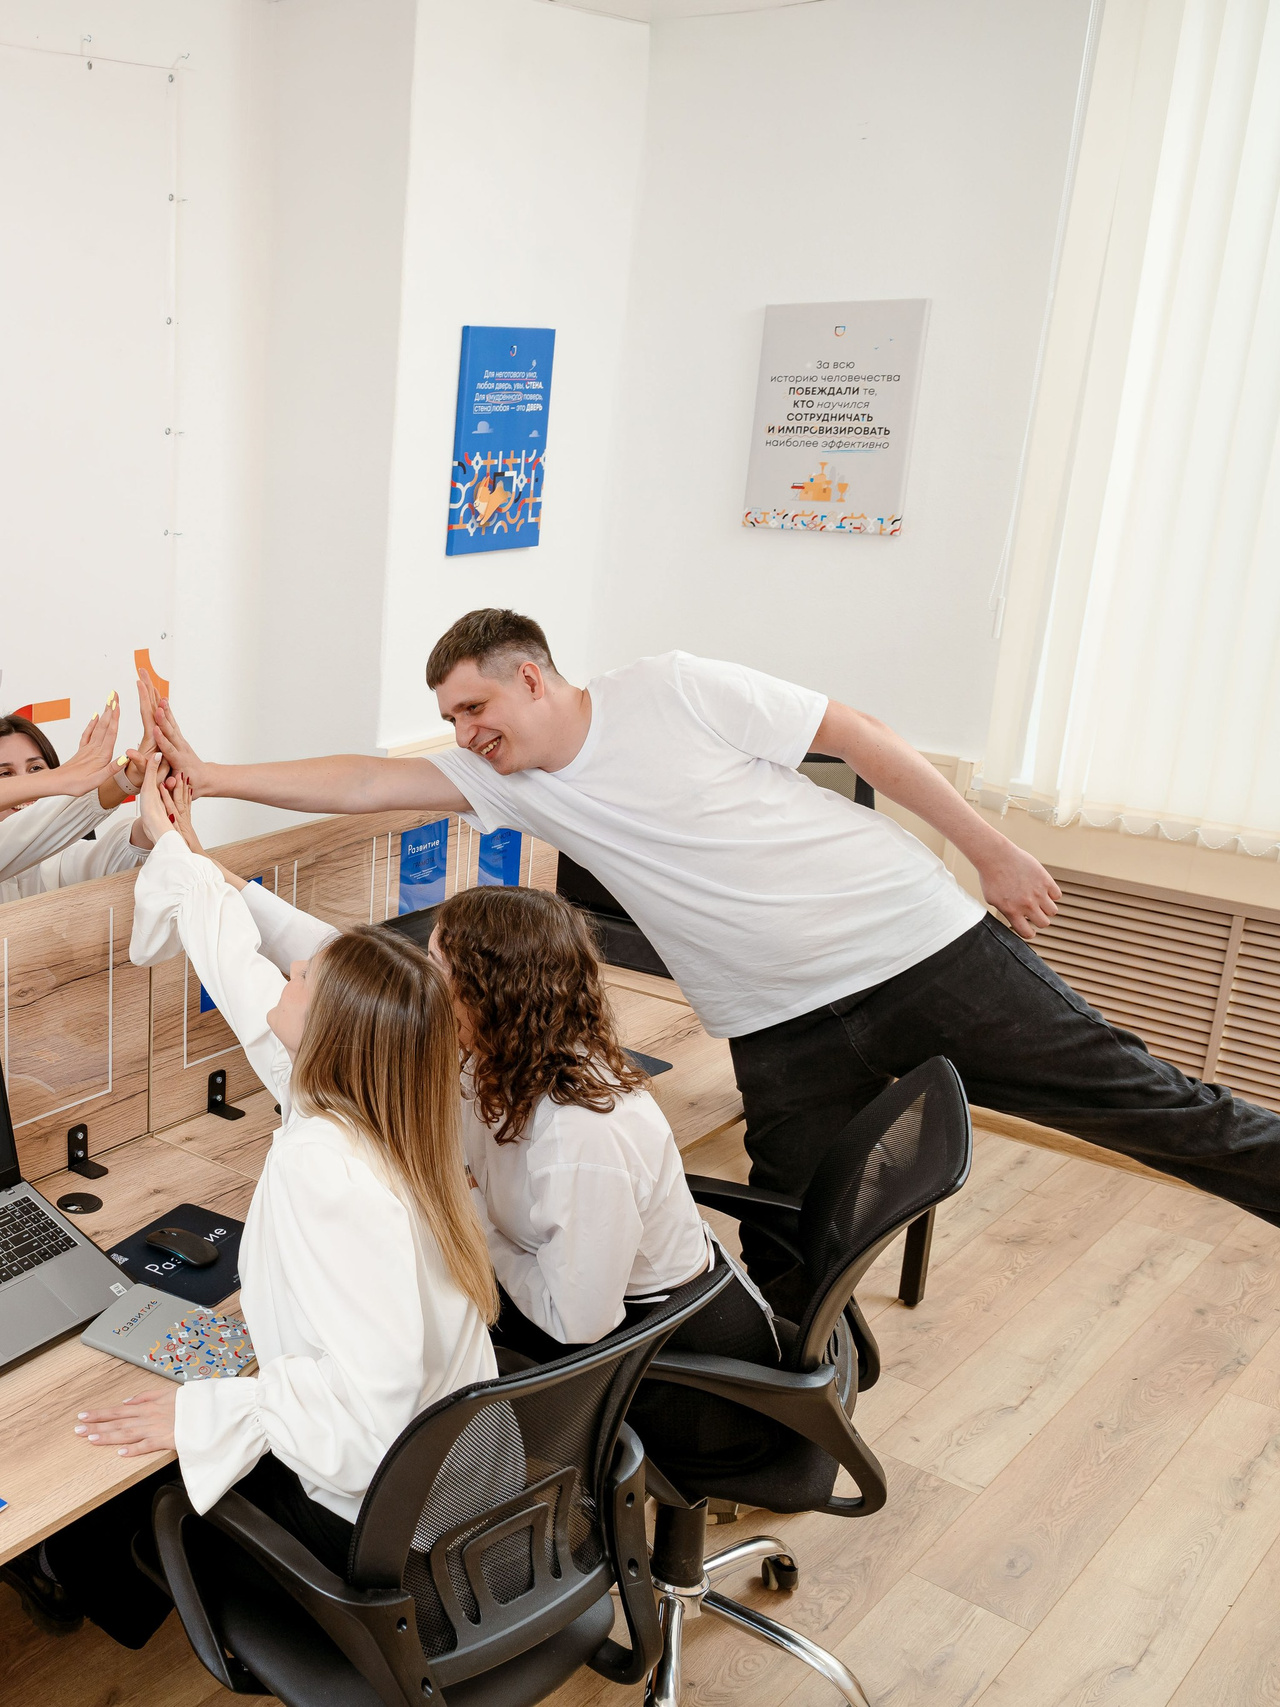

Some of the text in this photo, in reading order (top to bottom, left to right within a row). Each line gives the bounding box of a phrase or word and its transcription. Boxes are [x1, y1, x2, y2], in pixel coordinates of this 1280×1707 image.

[816, 360, 855, 369] За всю
[484, 370, 494, 379] Для
[770, 374, 900, 384] историю человечества
[476, 381, 495, 390] любая
[788, 386, 878, 396] ПОБЕЖДАЛИ те,
[474, 393, 485, 402] Для
[492, 403, 510, 412] любая
[526, 403, 543, 412] ДВЕРЬ
[792, 400, 870, 410] КТО научился
[786, 412, 874, 422] СОТРУДНИЧАТЬ
[767, 425, 890, 436] И ИМПРОВИЗИРОВАТЬ
[765, 438, 890, 449] наиболее эффективно
[408, 839, 440, 855] Развитие
[112, 1300, 158, 1337] Развитие
